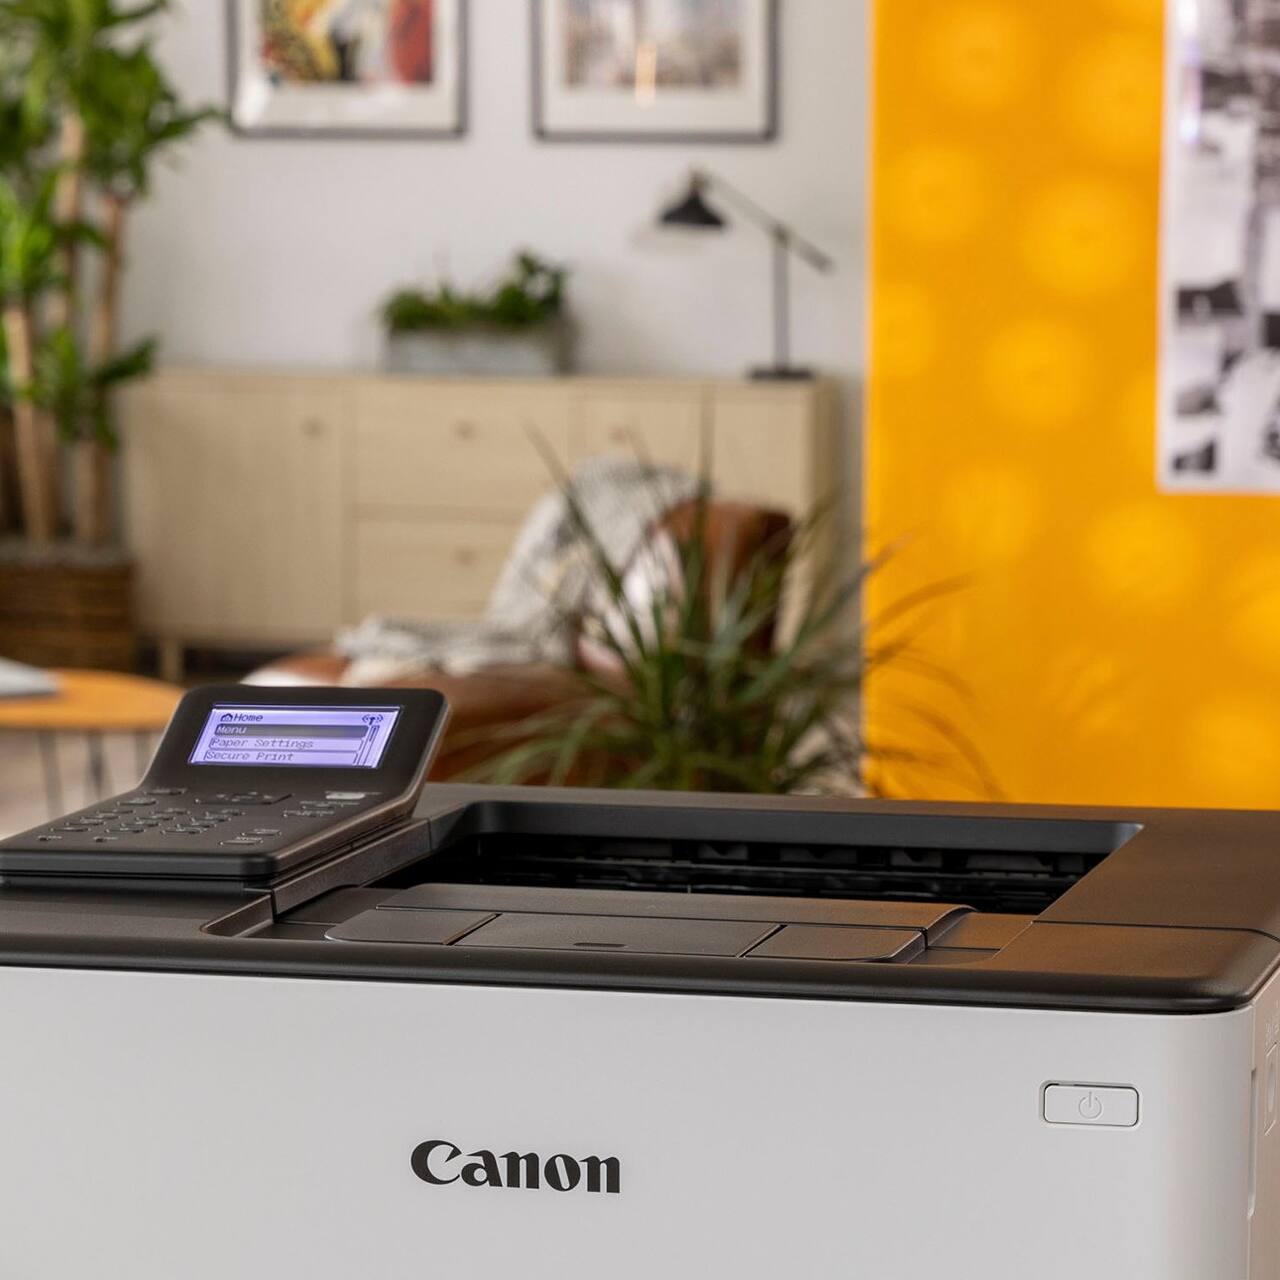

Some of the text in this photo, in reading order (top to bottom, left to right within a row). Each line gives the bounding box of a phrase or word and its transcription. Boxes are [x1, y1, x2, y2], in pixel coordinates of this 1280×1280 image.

[233, 713, 264, 723] Home
[217, 725, 247, 735] Menu
[210, 738, 314, 750] Paper Settings
[206, 751, 294, 761] Secure Print
[410, 1139, 620, 1194] Canon
